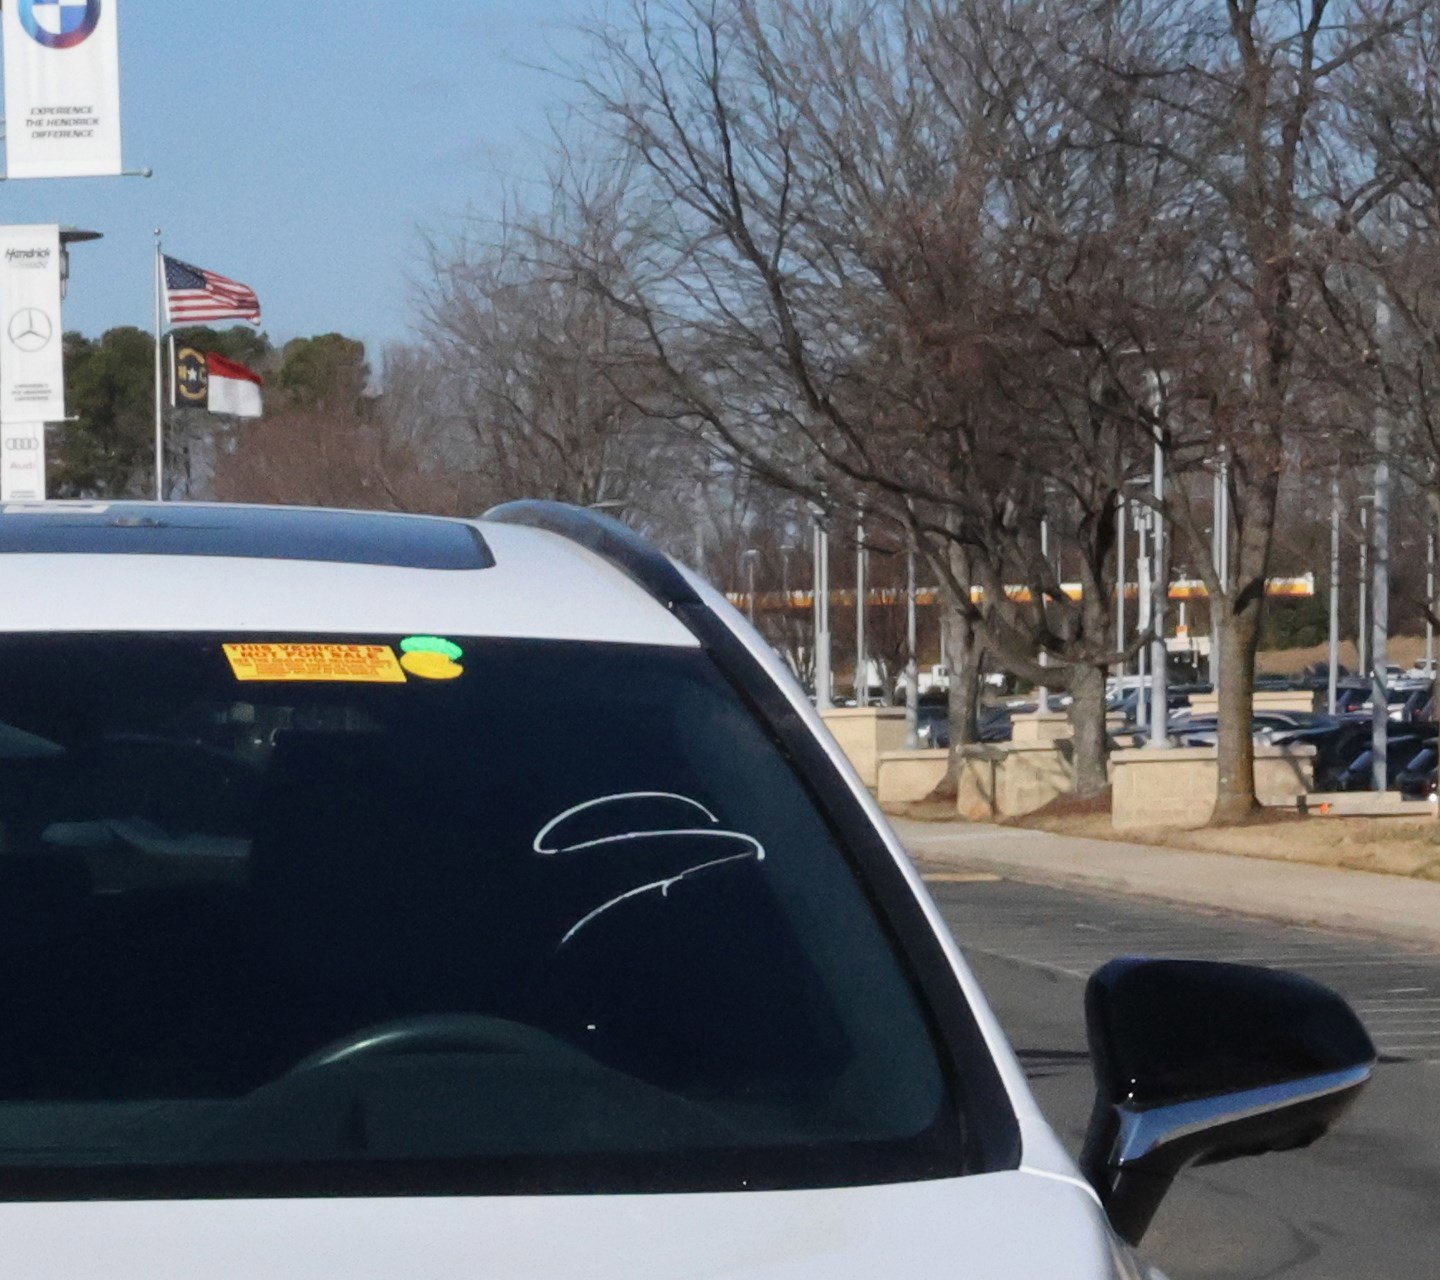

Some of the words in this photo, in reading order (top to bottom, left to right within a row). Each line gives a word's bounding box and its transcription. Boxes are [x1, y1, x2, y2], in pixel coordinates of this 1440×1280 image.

[30, 105, 93, 115] EXPERIENCE
[25, 118, 43, 127] THE
[46, 118, 99, 127] HENDRICK
[31, 129, 93, 138] DIFFERENCE
[5, 247, 51, 261] Hendrick
